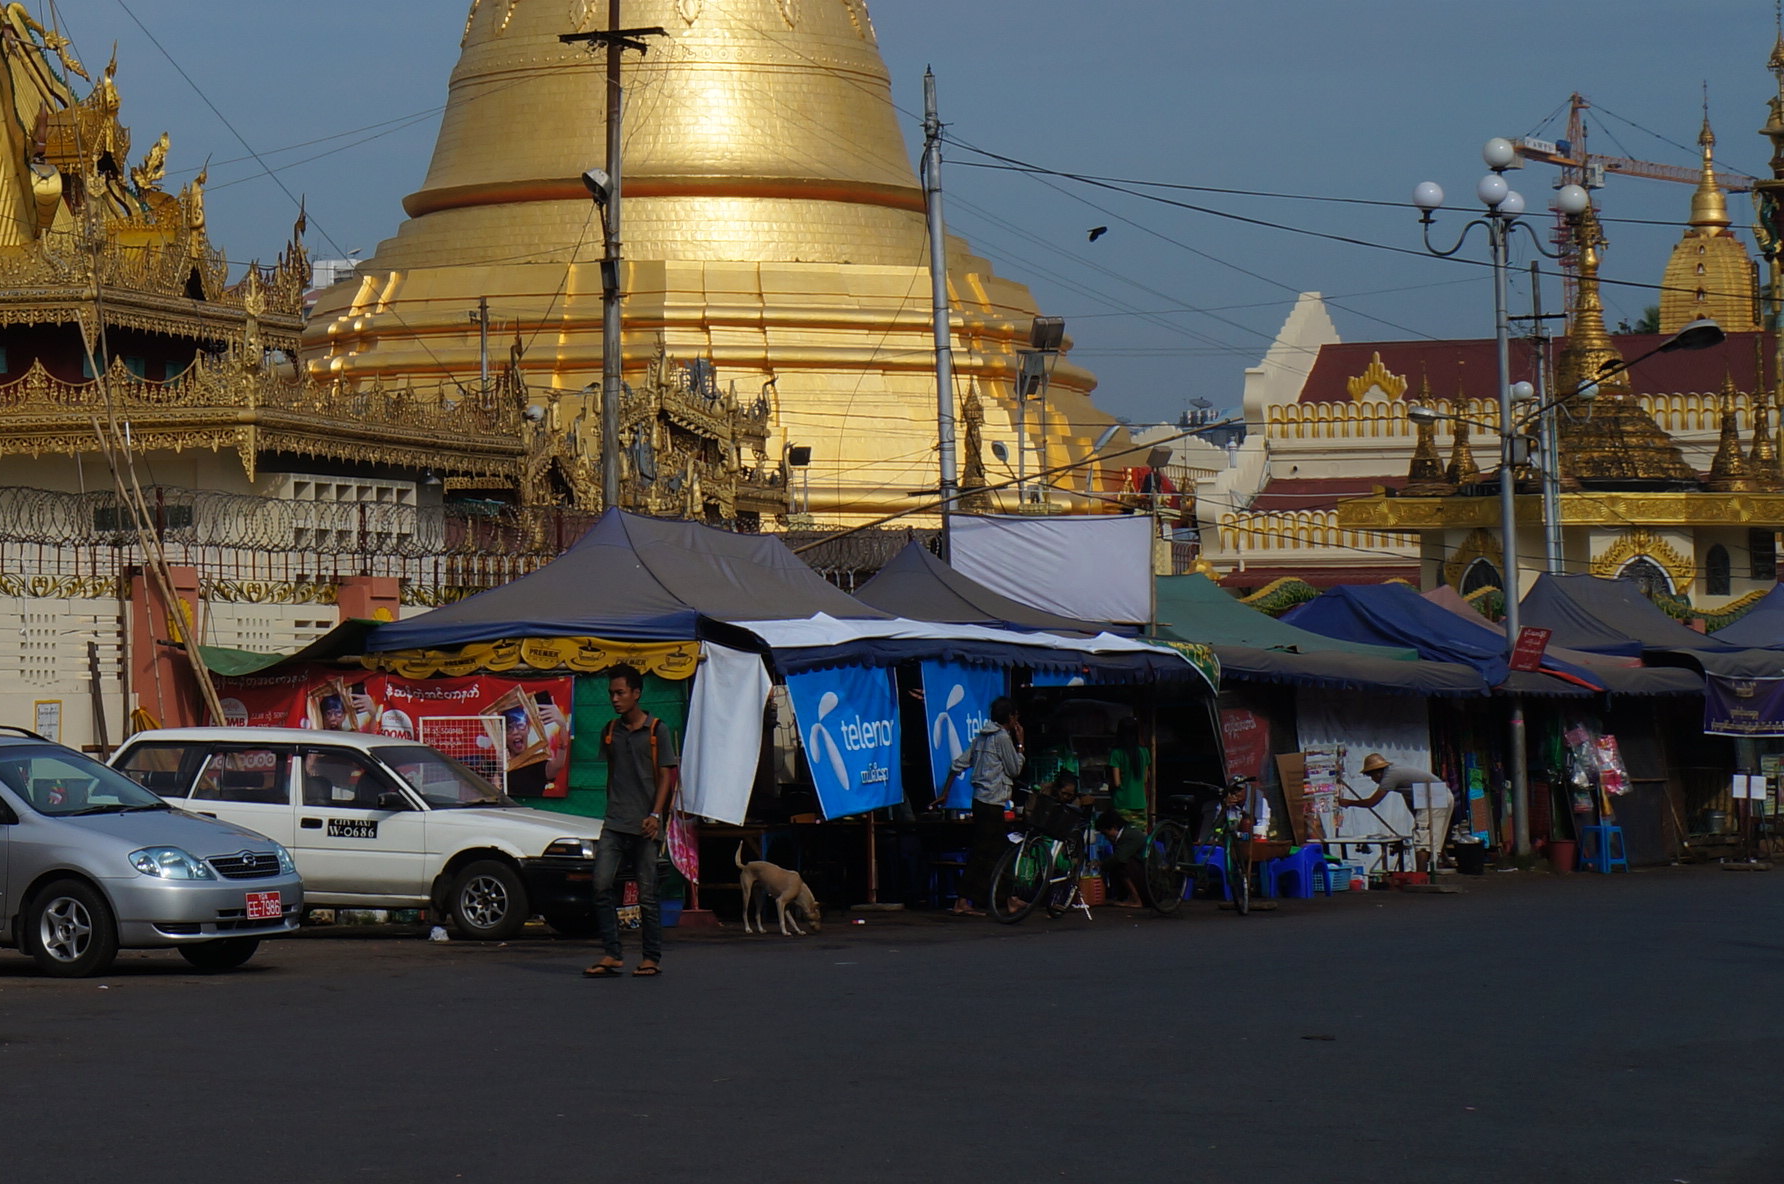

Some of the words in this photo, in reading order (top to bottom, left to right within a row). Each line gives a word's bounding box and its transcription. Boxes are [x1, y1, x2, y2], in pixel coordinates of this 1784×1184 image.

[528, 648, 559, 658] PREMIER
[384, 682, 480, 704] န်ဆန်တဲ့အင်တာနက်
[841, 715, 893, 750] telenor
[354, 819, 371, 827] TAXI
